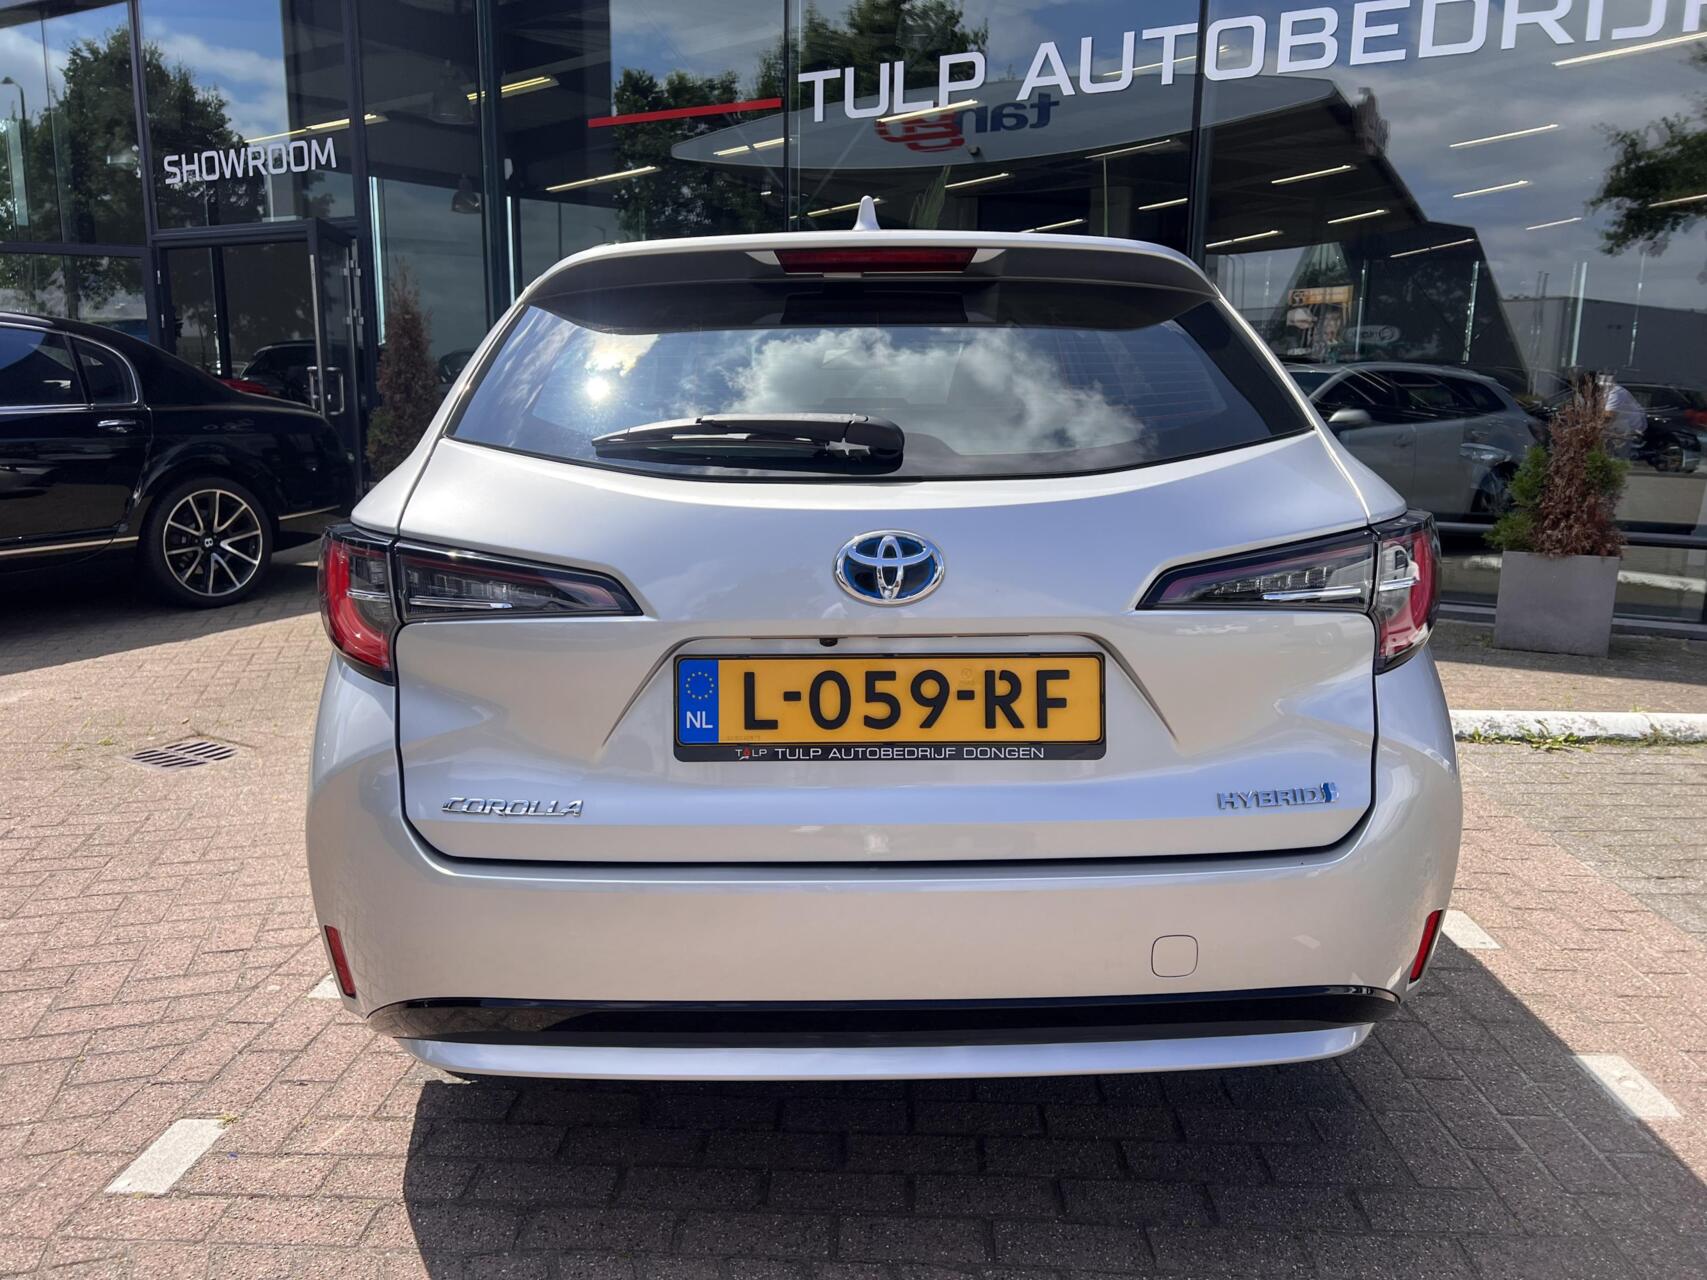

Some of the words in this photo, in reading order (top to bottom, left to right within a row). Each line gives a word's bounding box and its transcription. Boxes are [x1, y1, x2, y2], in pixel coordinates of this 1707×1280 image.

[798, 52, 986, 122] TULP
[163, 137, 337, 185] SHOWROOM
[744, 669, 1070, 730] L-059-RF
[686, 711, 714, 729] NL
[775, 748, 822, 760] TULP
[828, 747, 957, 760] AUTOBEDRIJF
[963, 747, 1045, 760] DONGEN
[441, 797, 584, 818] COROLLA
[1217, 786, 1325, 810] HYBRID
